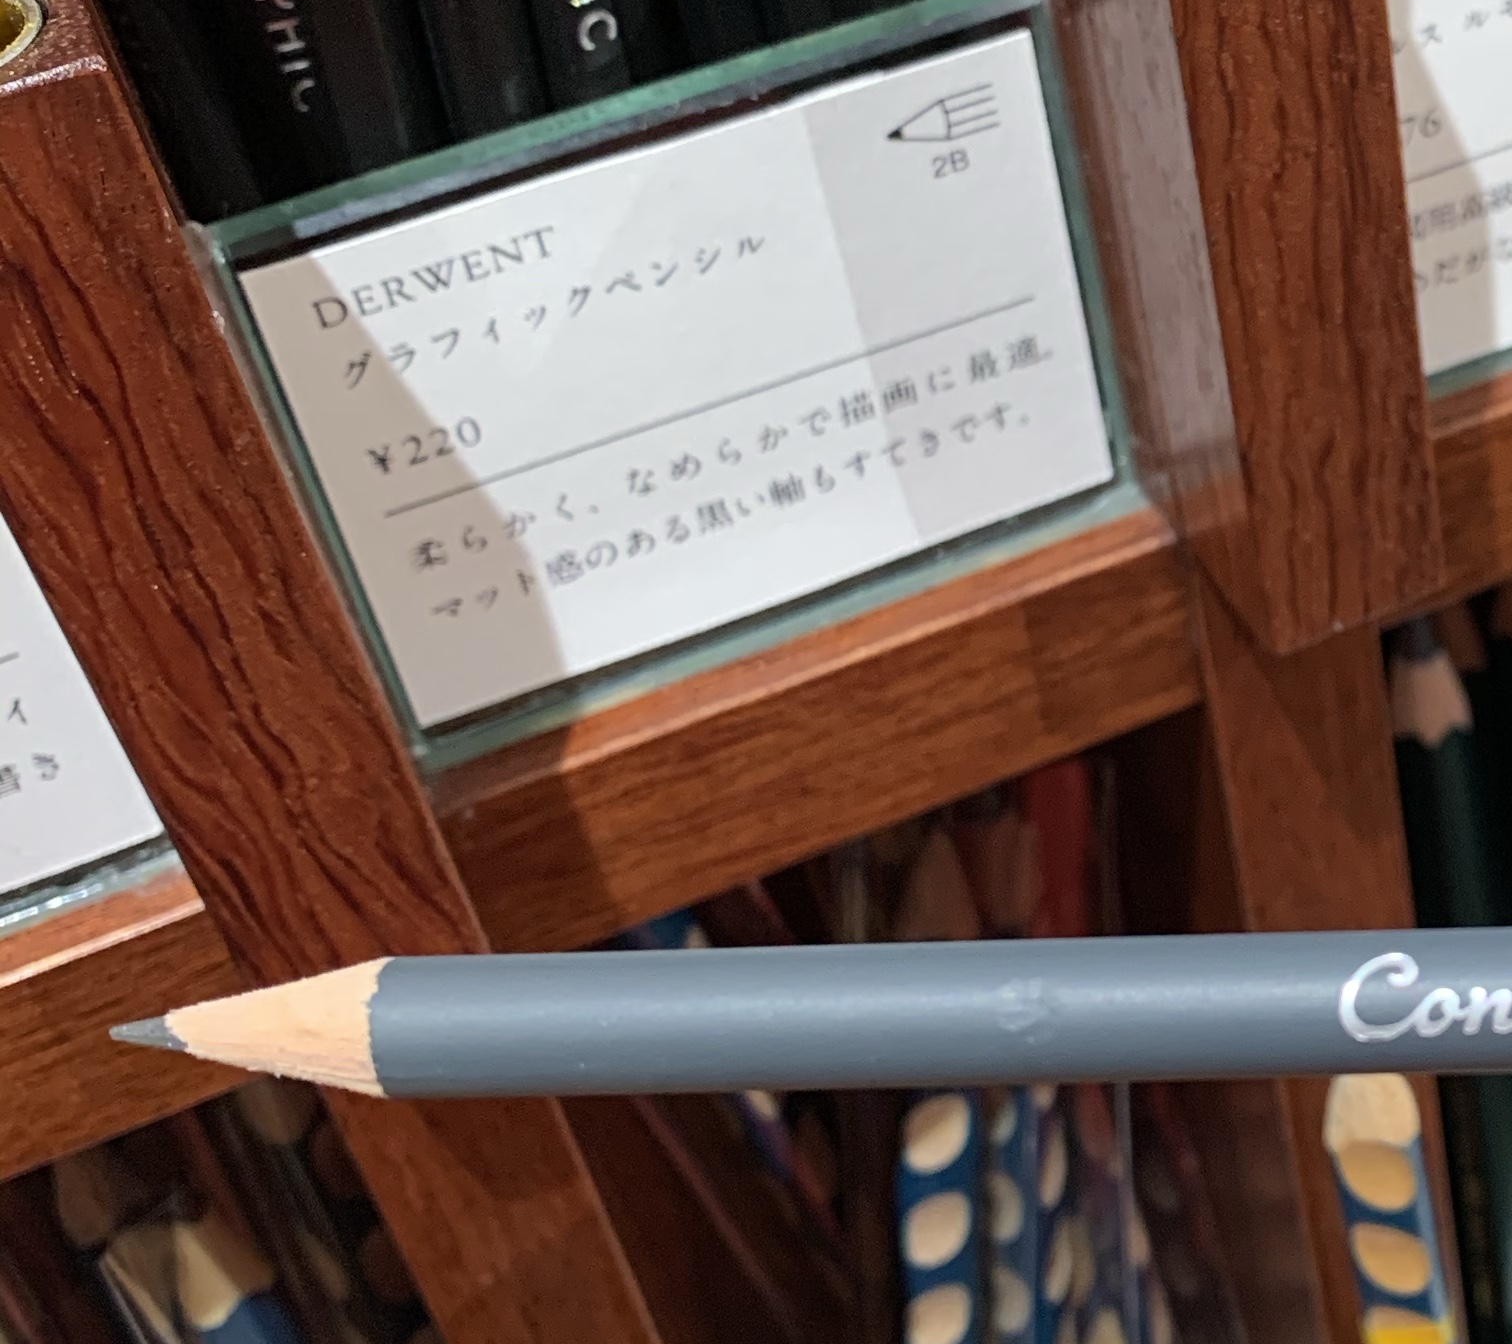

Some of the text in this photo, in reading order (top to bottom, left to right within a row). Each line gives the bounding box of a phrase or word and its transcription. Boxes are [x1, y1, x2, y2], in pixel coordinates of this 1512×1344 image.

[931, 148, 971, 180] 2B
[310, 224, 555, 331] DERWENT
[342, 234, 767, 391] グラフィックペンシル
[367, 415, 483, 476] ¥220
